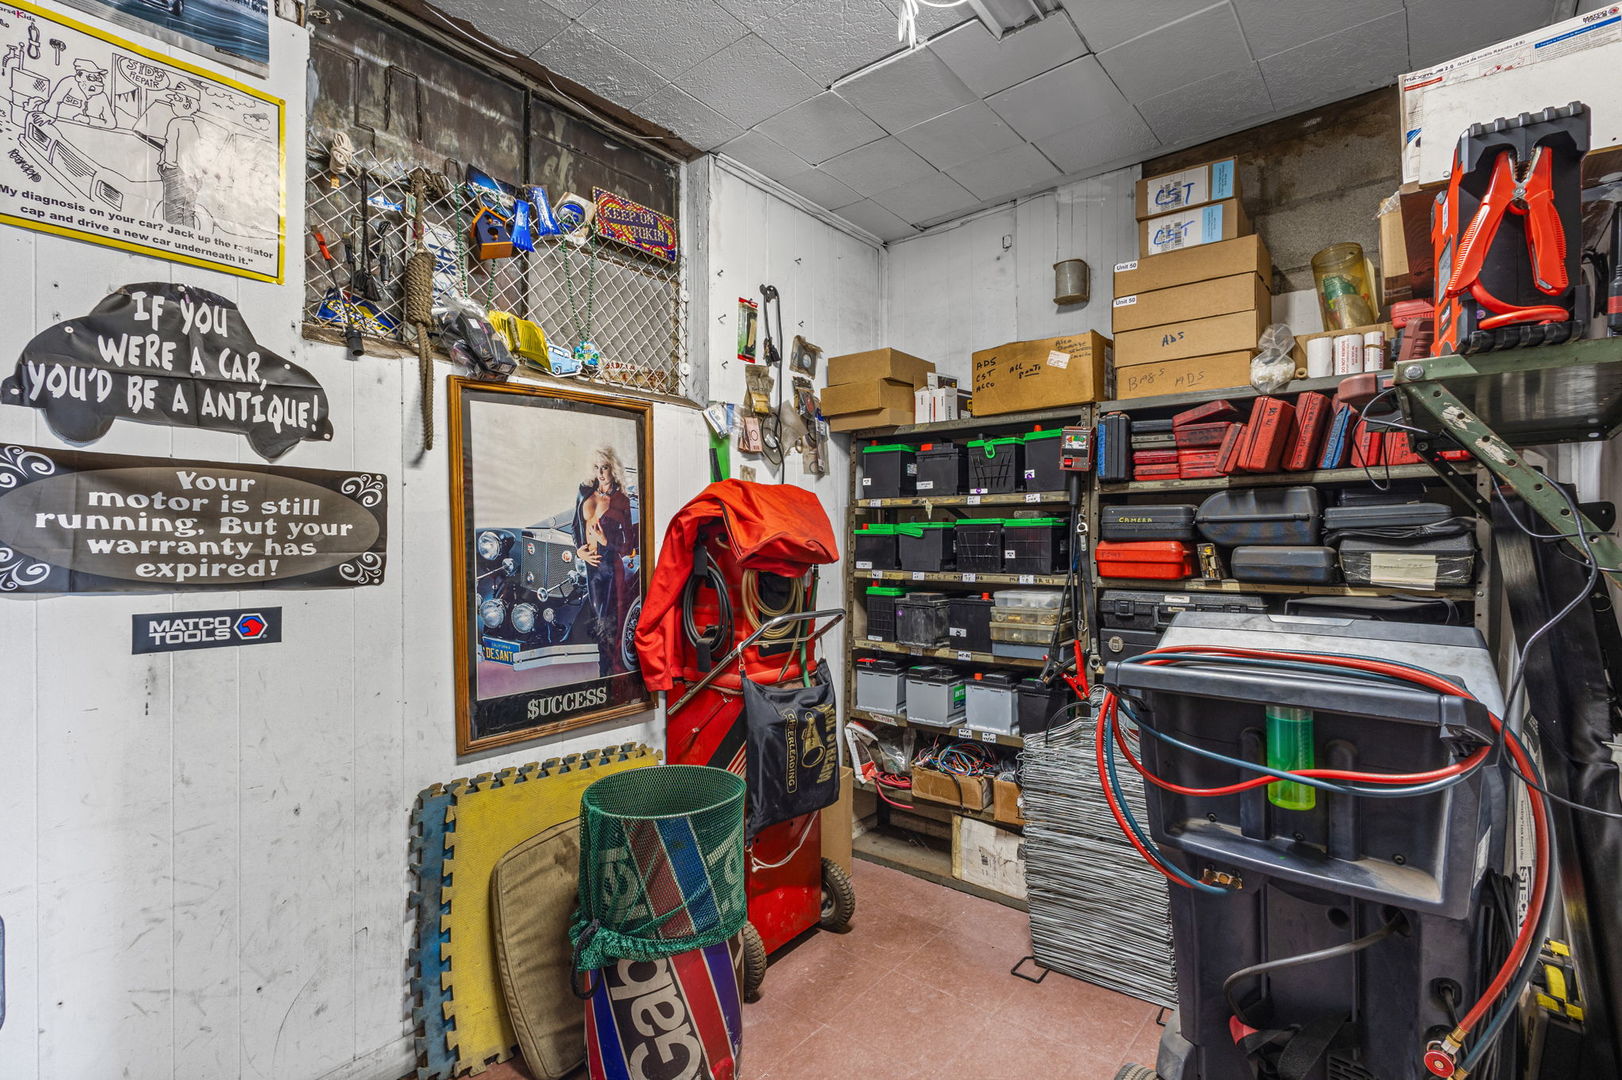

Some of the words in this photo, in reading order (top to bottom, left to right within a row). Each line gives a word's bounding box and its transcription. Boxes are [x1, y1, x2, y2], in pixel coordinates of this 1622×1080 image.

[127, 58, 165, 82] SID'S
[129, 71, 160, 89] REPAIR
[65, 95, 80, 106] SID
[1155, 182, 1195, 205] CST
[22, 190, 85, 212] diagnosis
[90, 208, 105, 217] on
[108, 211, 135, 224] your
[139, 217, 164, 231] car?
[167, 225, 194, 239] Jack
[198, 233, 211, 244] up
[214, 236, 231, 248] the
[20, 205, 45, 219] cap
[50, 209, 74, 224] and
[78, 215, 109, 232] drive
[113, 227, 120, 235] a
[124, 229, 149, 241] new
[152, 236, 171, 246] car
[174, 241, 236, 263] underneath
[1153, 220, 1195, 246] CST
[131, 291, 164, 331] IF
[180, 302, 228, 337] YOU
[98, 334, 177, 372] WERE
[190, 347, 206, 376] A
[218, 347, 267, 391] CAR,
[976, 356, 998, 371] ADS
[976, 368, 996, 383] CST
[28, 360, 113, 402] YOU'D
[127, 375, 158, 414] BE
[172, 384, 189, 414] A
[201, 388, 319, 434] ANTIQUE!
[176, 471, 256, 491] Your
[88, 491, 209, 512] motor
[221, 494, 250, 513] is
[261, 499, 320, 516] still
[219, 517, 278, 535] But
[288, 521, 353, 539] your
[87, 538, 254, 559] warranty
[264, 538, 317, 556] has
[135, 559, 279, 582] expired!
[149, 617, 231, 633] MATCO
[149, 630, 231, 646] TOOLS
